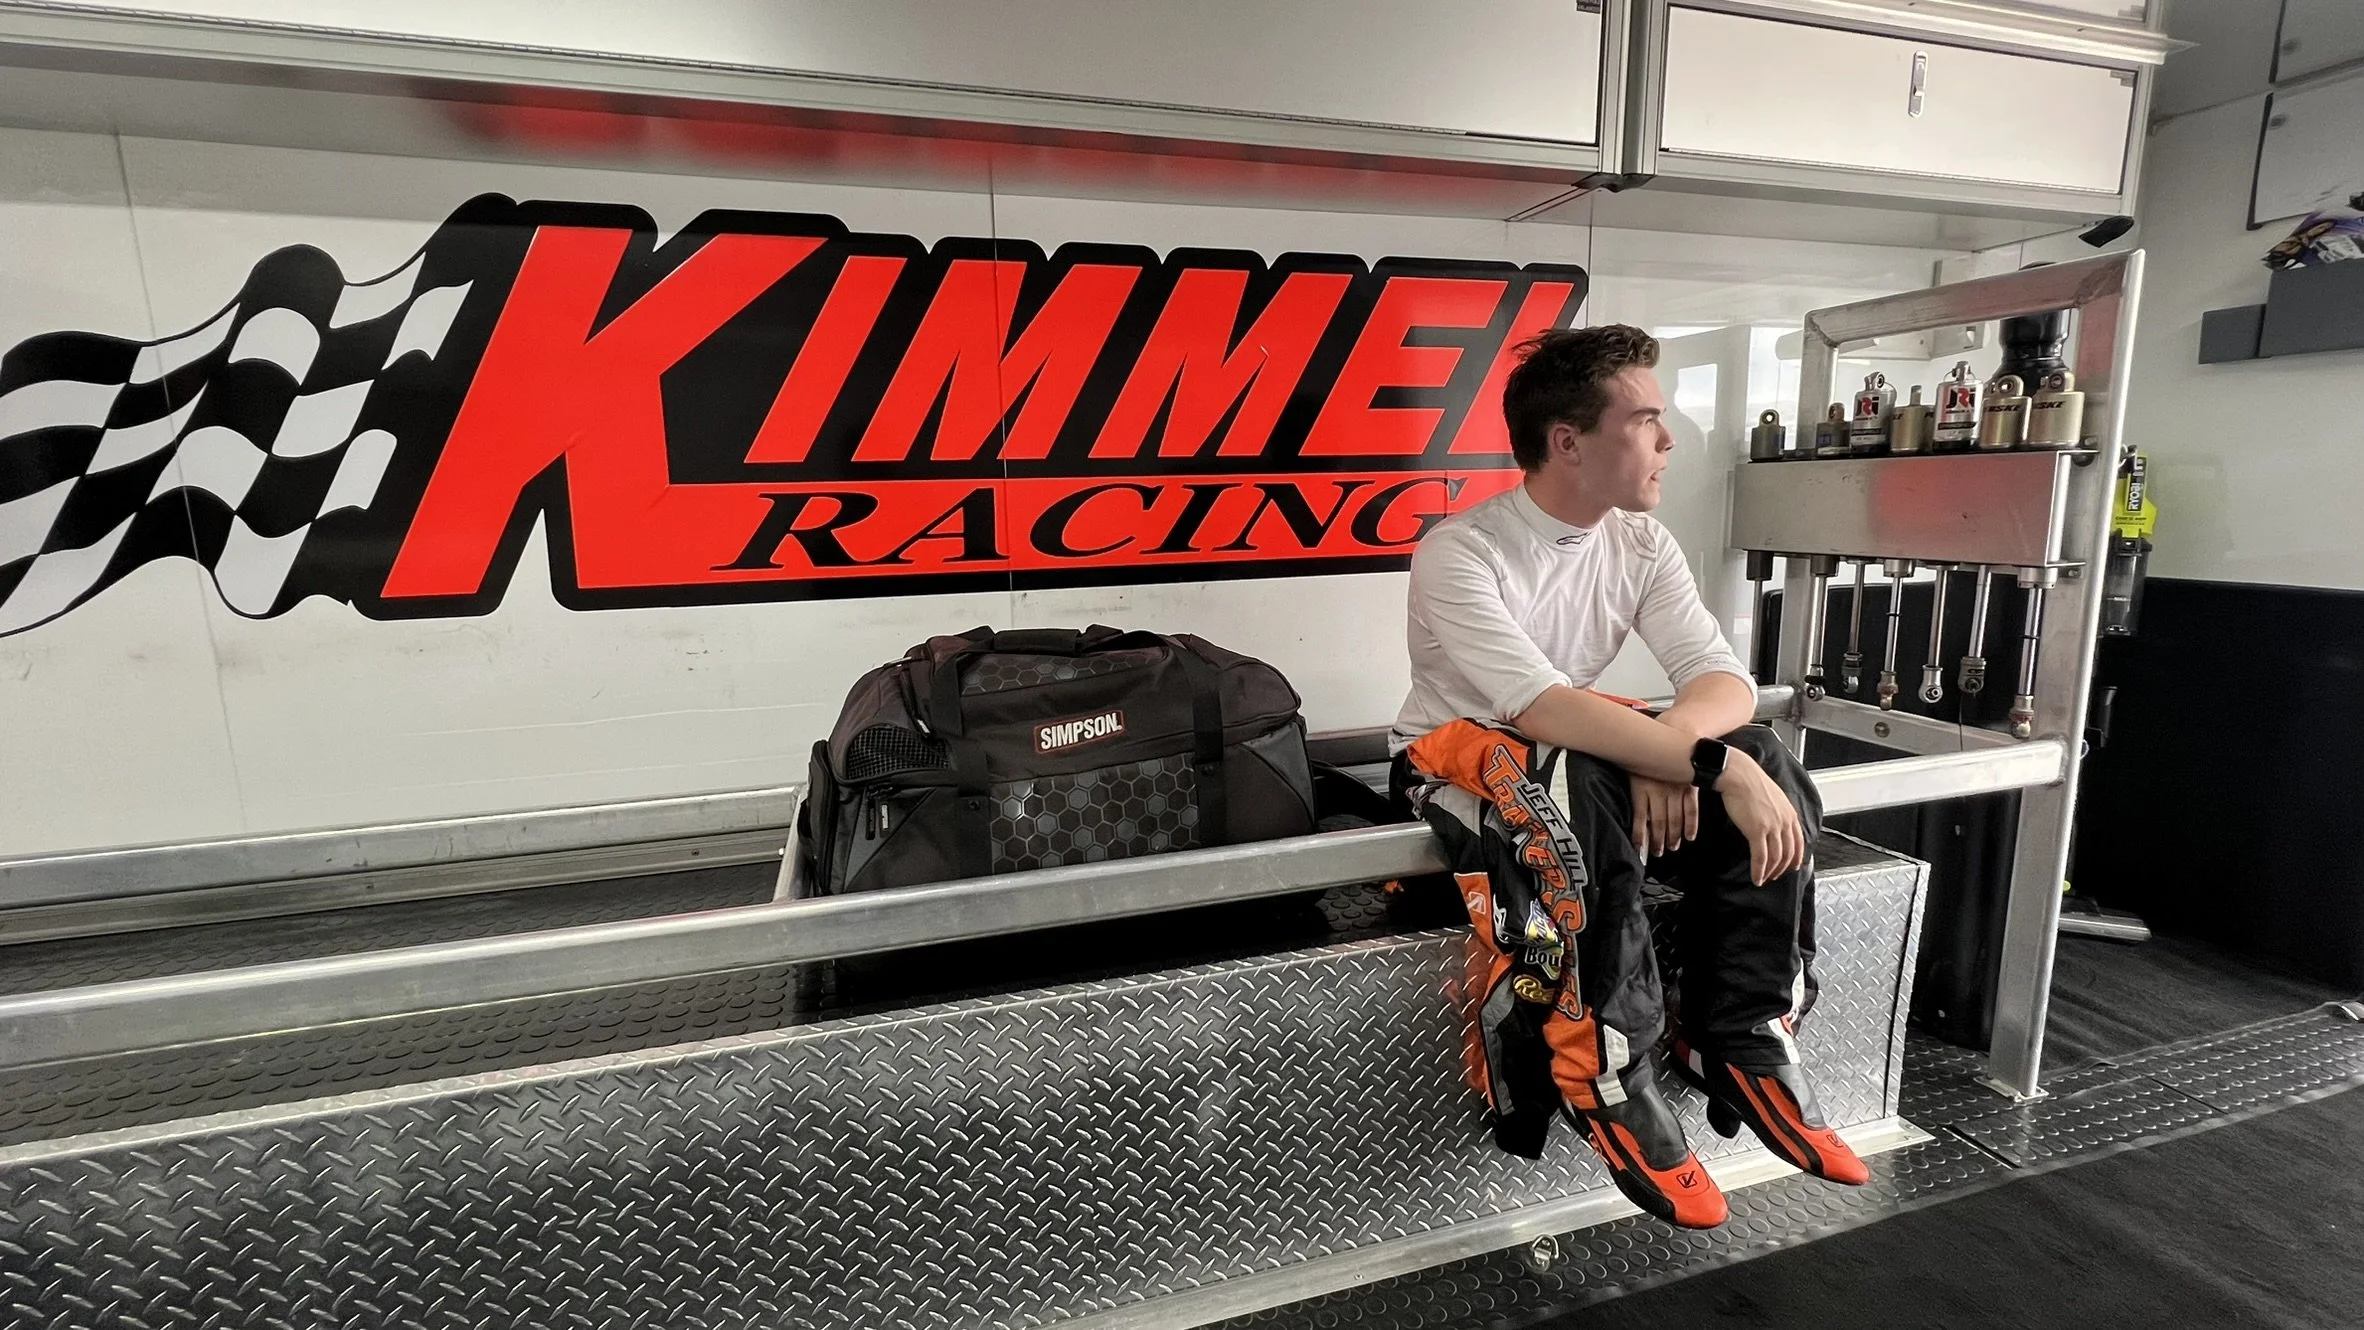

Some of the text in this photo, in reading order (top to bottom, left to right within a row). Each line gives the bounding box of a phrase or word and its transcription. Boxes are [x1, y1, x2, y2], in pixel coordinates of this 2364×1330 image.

[709, 477, 1468, 571] RACING
[2128, 482, 2142, 510] RYOBI
[1041, 713, 1118, 750] SIMPSON
[1521, 783, 1585, 891] JEFF HILL
